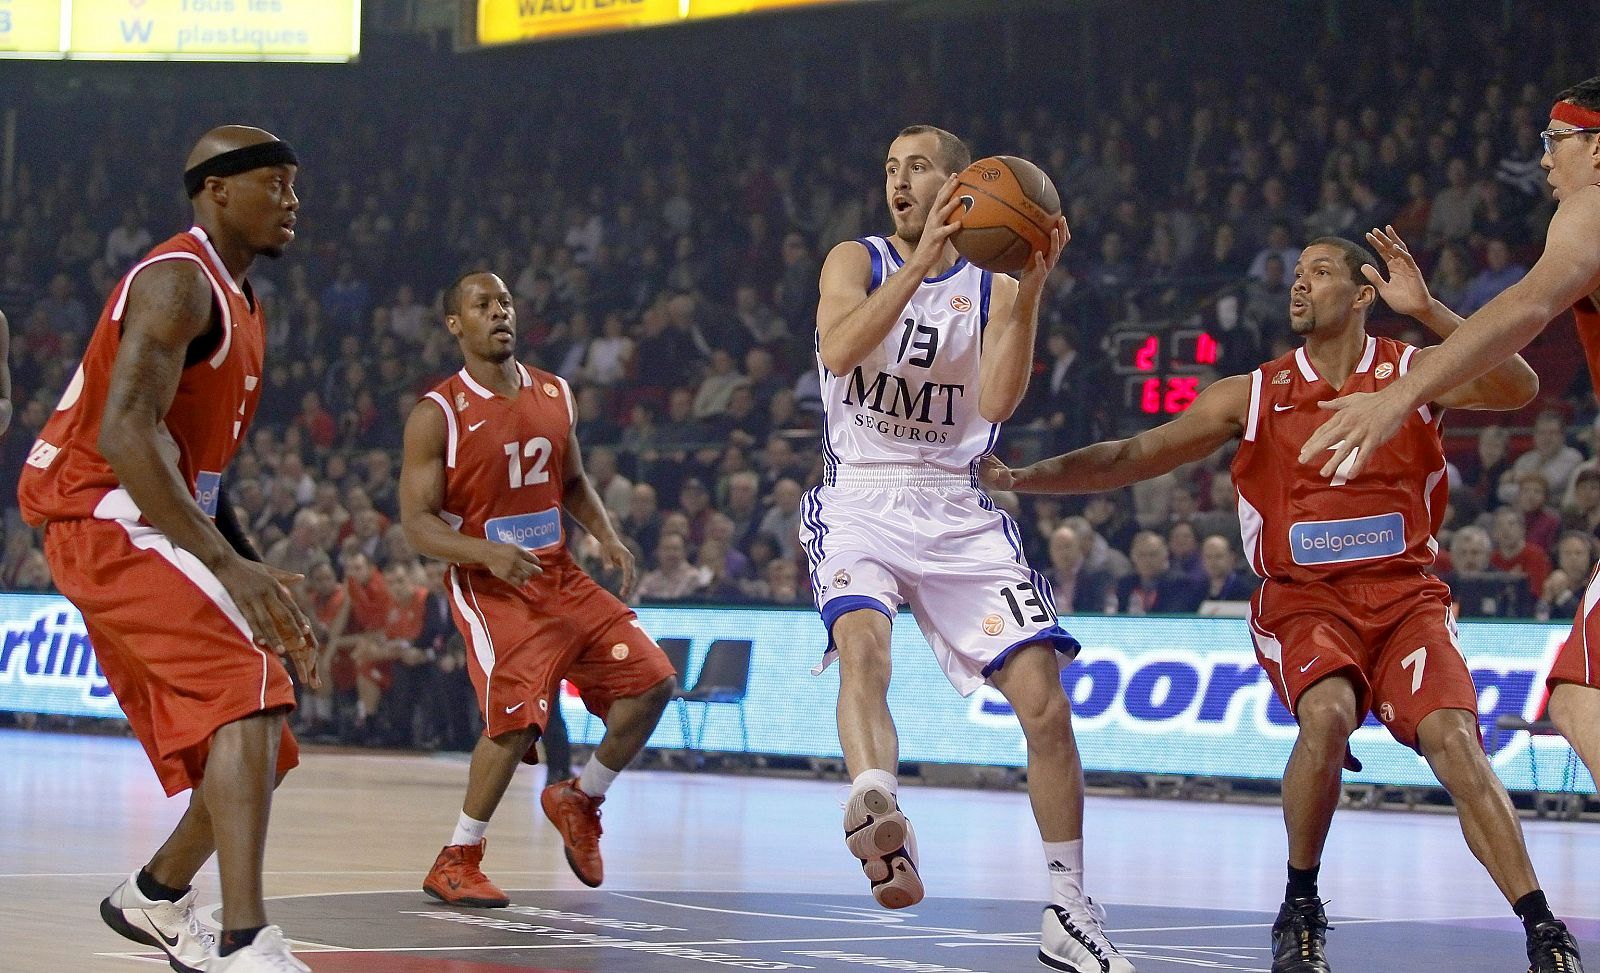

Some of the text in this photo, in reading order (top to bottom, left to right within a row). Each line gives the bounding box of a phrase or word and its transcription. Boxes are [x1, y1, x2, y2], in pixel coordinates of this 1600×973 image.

[177, 25, 310, 50] plastiques
[897, 318, 939, 369] 13
[842, 366, 965, 426] MMT
[854, 413, 948, 444] SEGUROS
[503, 436, 553, 489] 12
[496, 522, 555, 543] belgacom
[1301, 529, 1394, 552] belgacom
[1001, 582, 1050, 627] 13
[1401, 646, 1427, 695] 7
